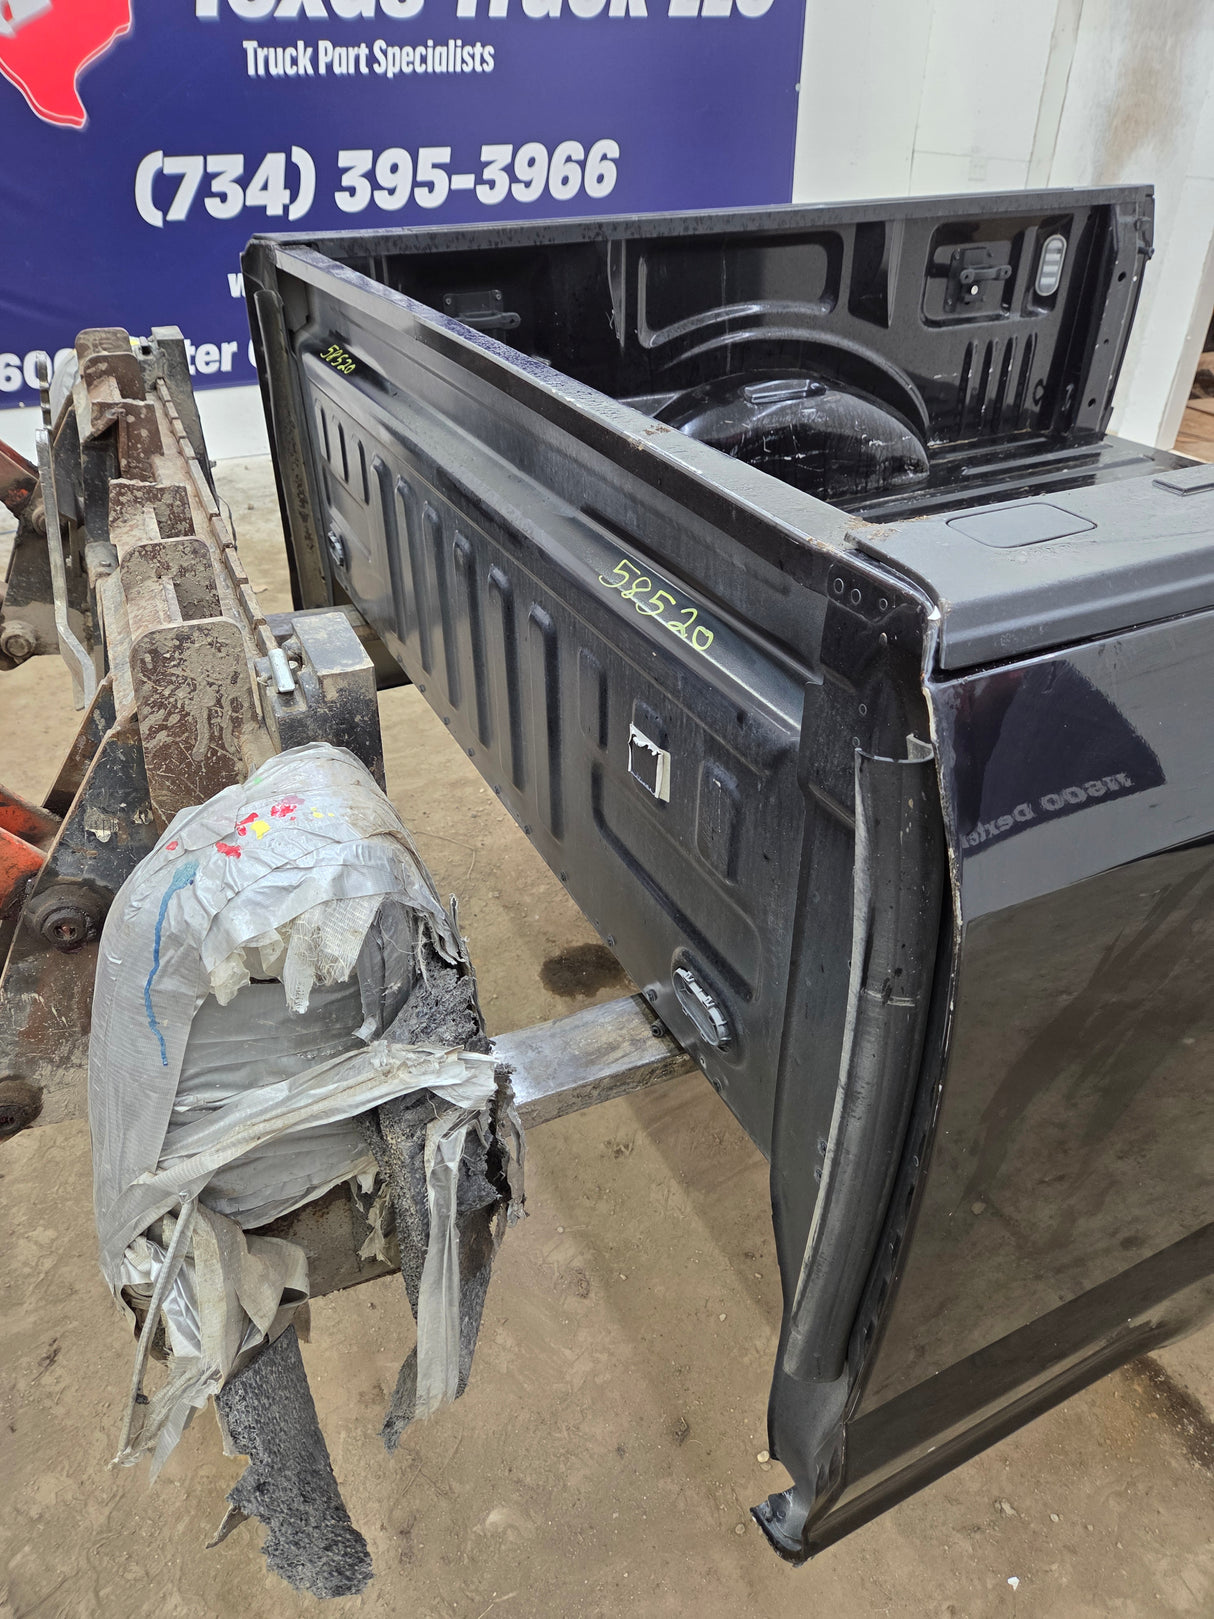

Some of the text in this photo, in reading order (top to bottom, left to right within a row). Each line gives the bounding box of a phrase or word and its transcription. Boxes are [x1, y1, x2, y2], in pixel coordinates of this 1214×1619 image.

[242, 38, 495, 78] Truck Part Specialists
[134, 138, 620, 228] (734) 395-3966
[320, 344, 356, 374] 58520
[598, 559, 714, 651] 58520
